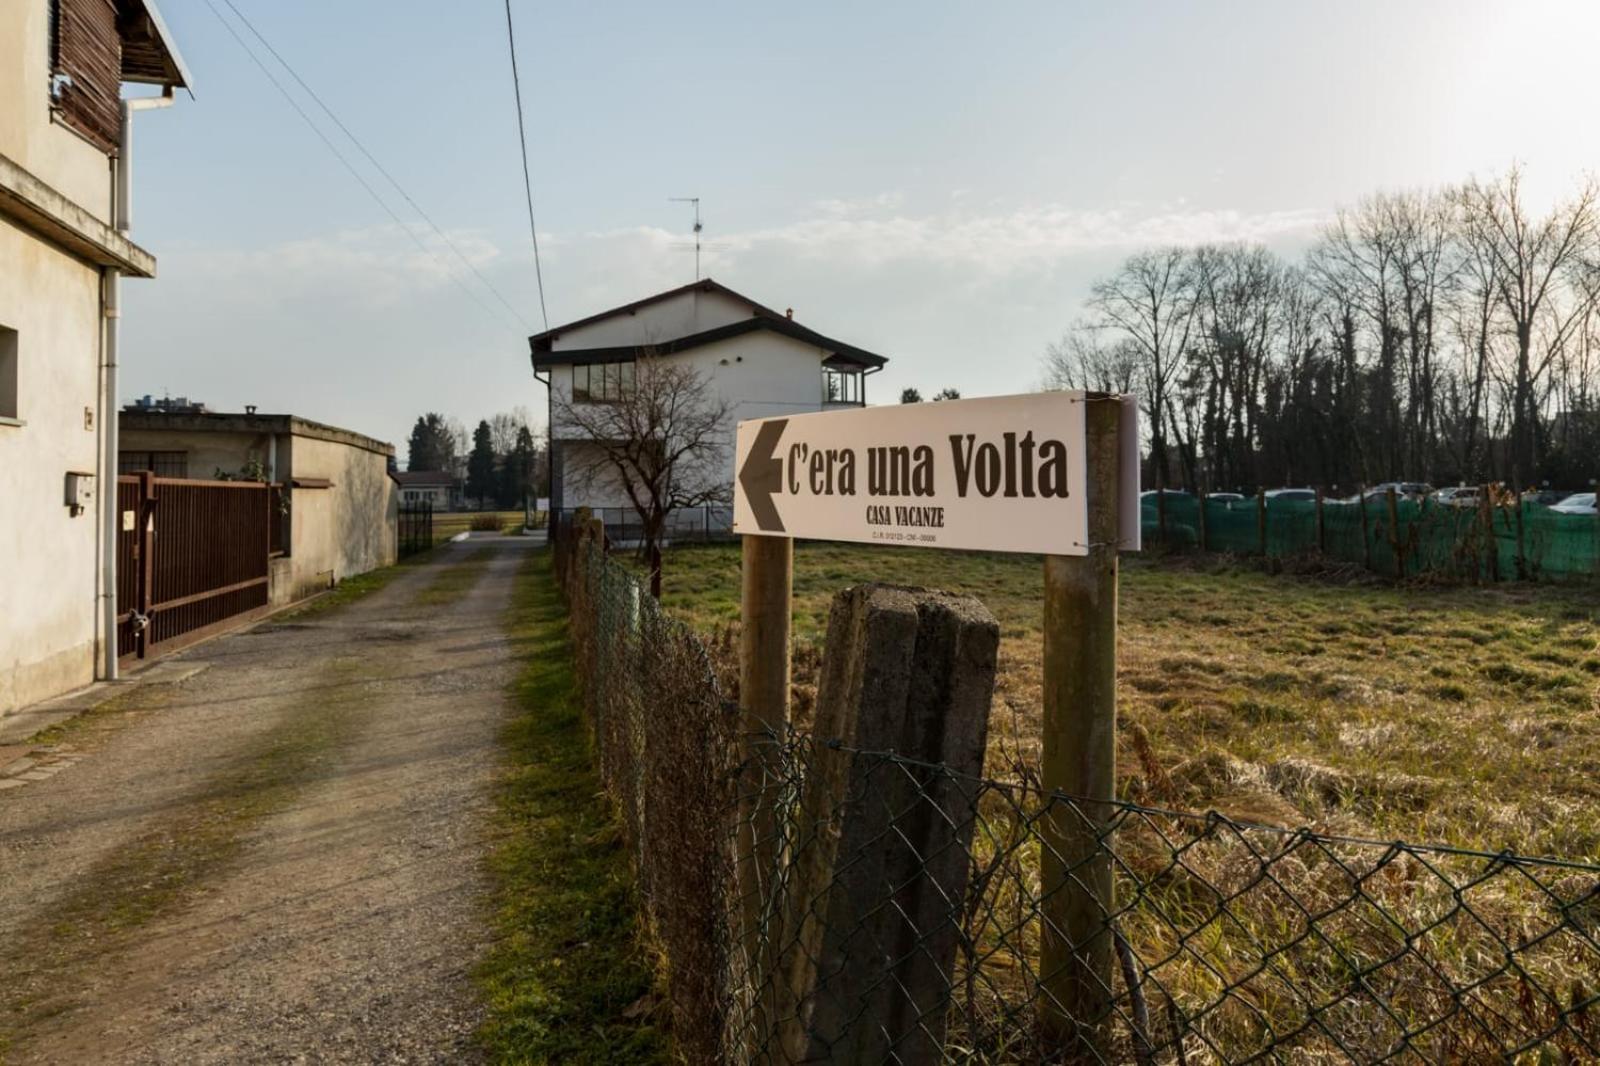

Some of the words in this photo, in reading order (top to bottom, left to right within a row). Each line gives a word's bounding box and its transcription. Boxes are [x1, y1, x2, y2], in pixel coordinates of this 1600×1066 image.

[788, 443, 856, 496] C'era
[867, 445, 935, 497] una
[949, 430, 1070, 499] Volta
[866, 505, 892, 526] CASA
[894, 505, 945, 528] VACANZE
